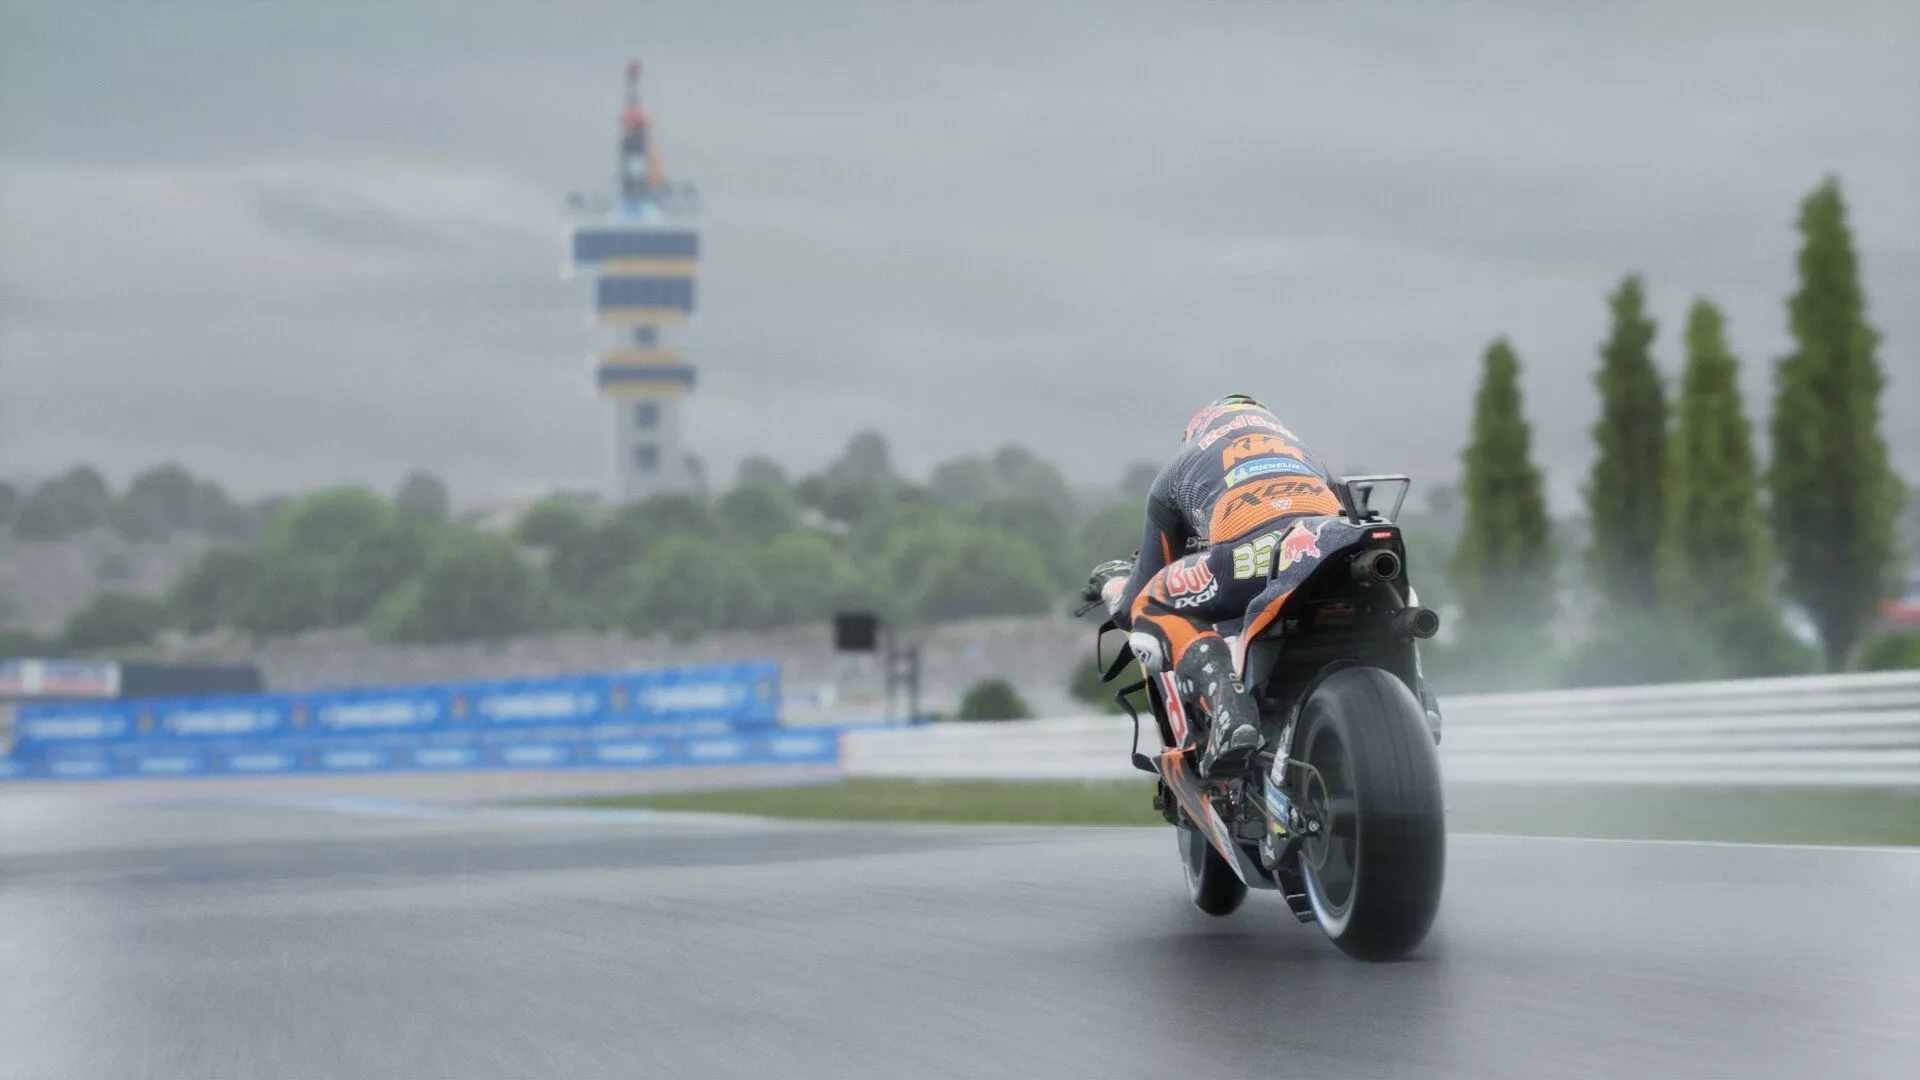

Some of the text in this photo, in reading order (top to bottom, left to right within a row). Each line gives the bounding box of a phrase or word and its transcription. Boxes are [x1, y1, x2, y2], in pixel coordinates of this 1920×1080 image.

[1222, 432, 1304, 471] KTM
[1249, 462, 1301, 472] MICHELIN
[1166, 556, 1214, 598] Bull
